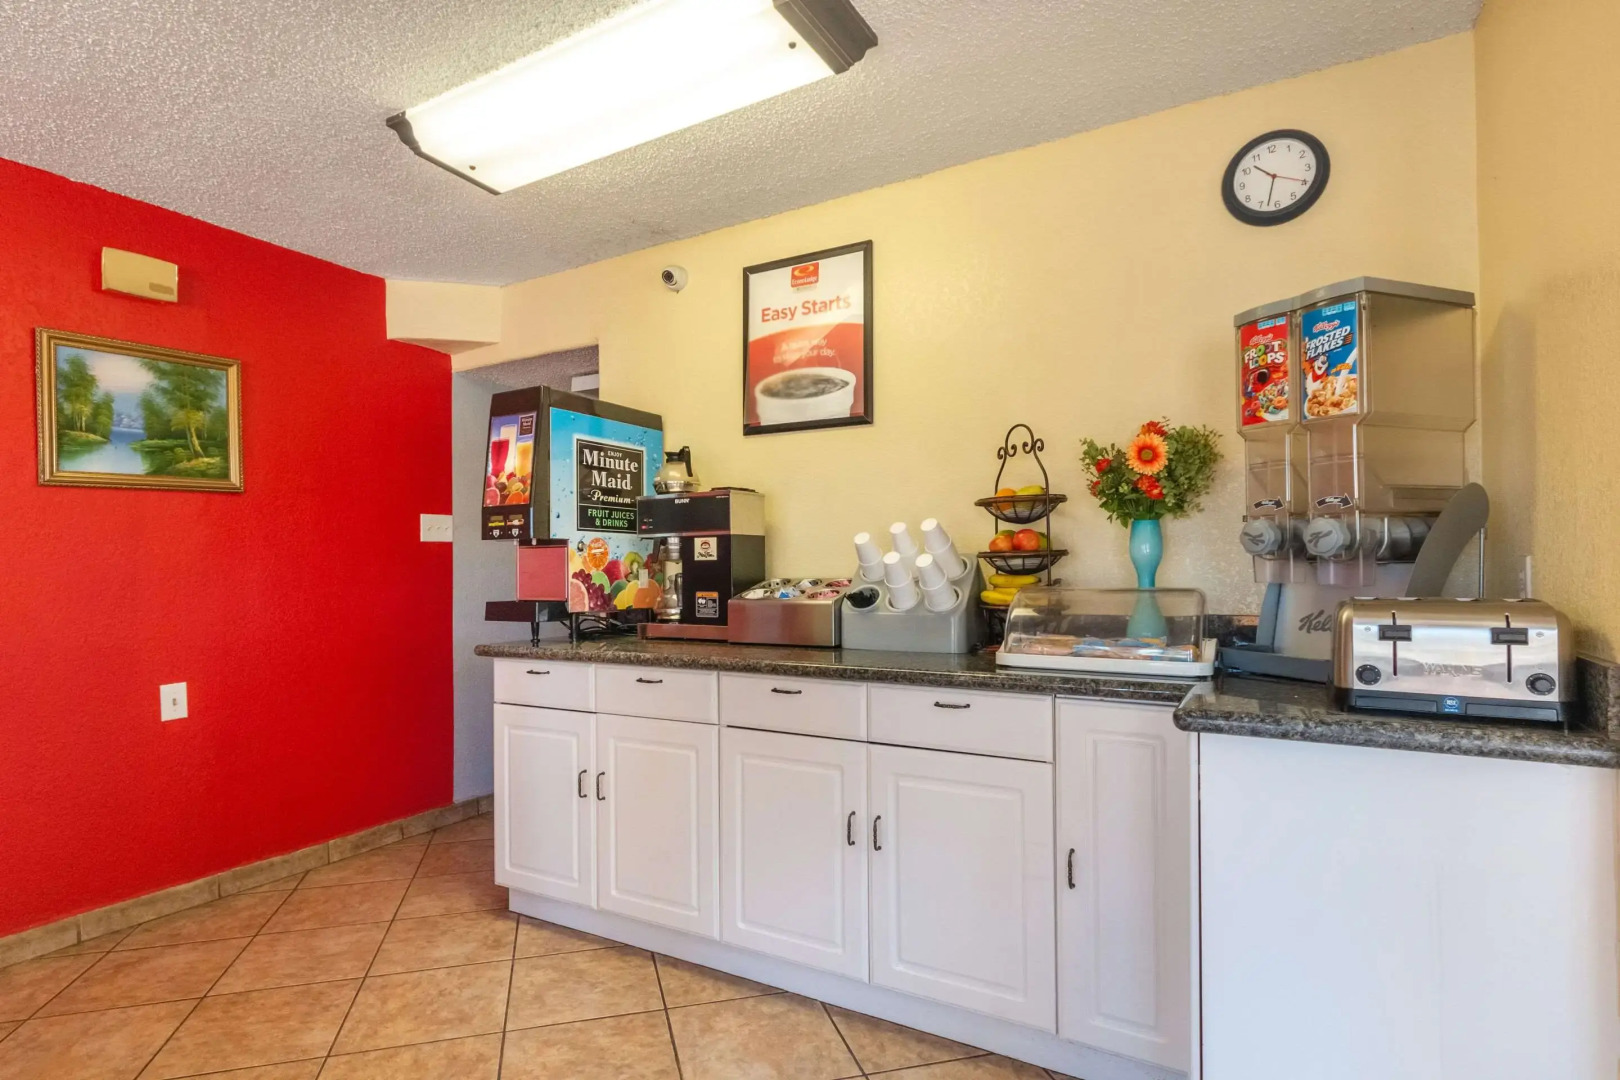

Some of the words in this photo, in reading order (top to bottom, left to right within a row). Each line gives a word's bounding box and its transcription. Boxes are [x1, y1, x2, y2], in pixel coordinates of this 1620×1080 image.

[1267, 145, 1277, 154] 12
[1287, 145, 1291, 153] 1
[1252, 154, 1261, 162] 11
[1299, 150, 1306, 159] 2
[1242, 167, 1252, 176] 10
[1305, 163, 1311, 172] 3
[1239, 182, 1246, 191] 9
[1300, 178, 1307, 186] 4
[1244, 194, 1251, 203] 8
[1290, 192, 1297, 201] 5
[1258, 201, 1264, 209] 7
[1274, 200, 1281, 208] 6
[761, 306, 798, 323] Easy
[801, 295, 851, 316] Starts
[1306, 325, 1351, 351] FROSTED
[1244, 340, 1282, 364] FROOT
[1306, 337, 1344, 361] FLAKES
[1249, 351, 1285, 370] LOOPS
[607, 450, 623, 458] ENJOY
[582, 448, 639, 473] Minute
[591, 470, 632, 490] Maid
[587, 508, 610, 518] FRUIT
[611, 510, 635, 520] JUICES
[595, 518, 601, 526] &
[602, 519, 628, 528] DRINKS
